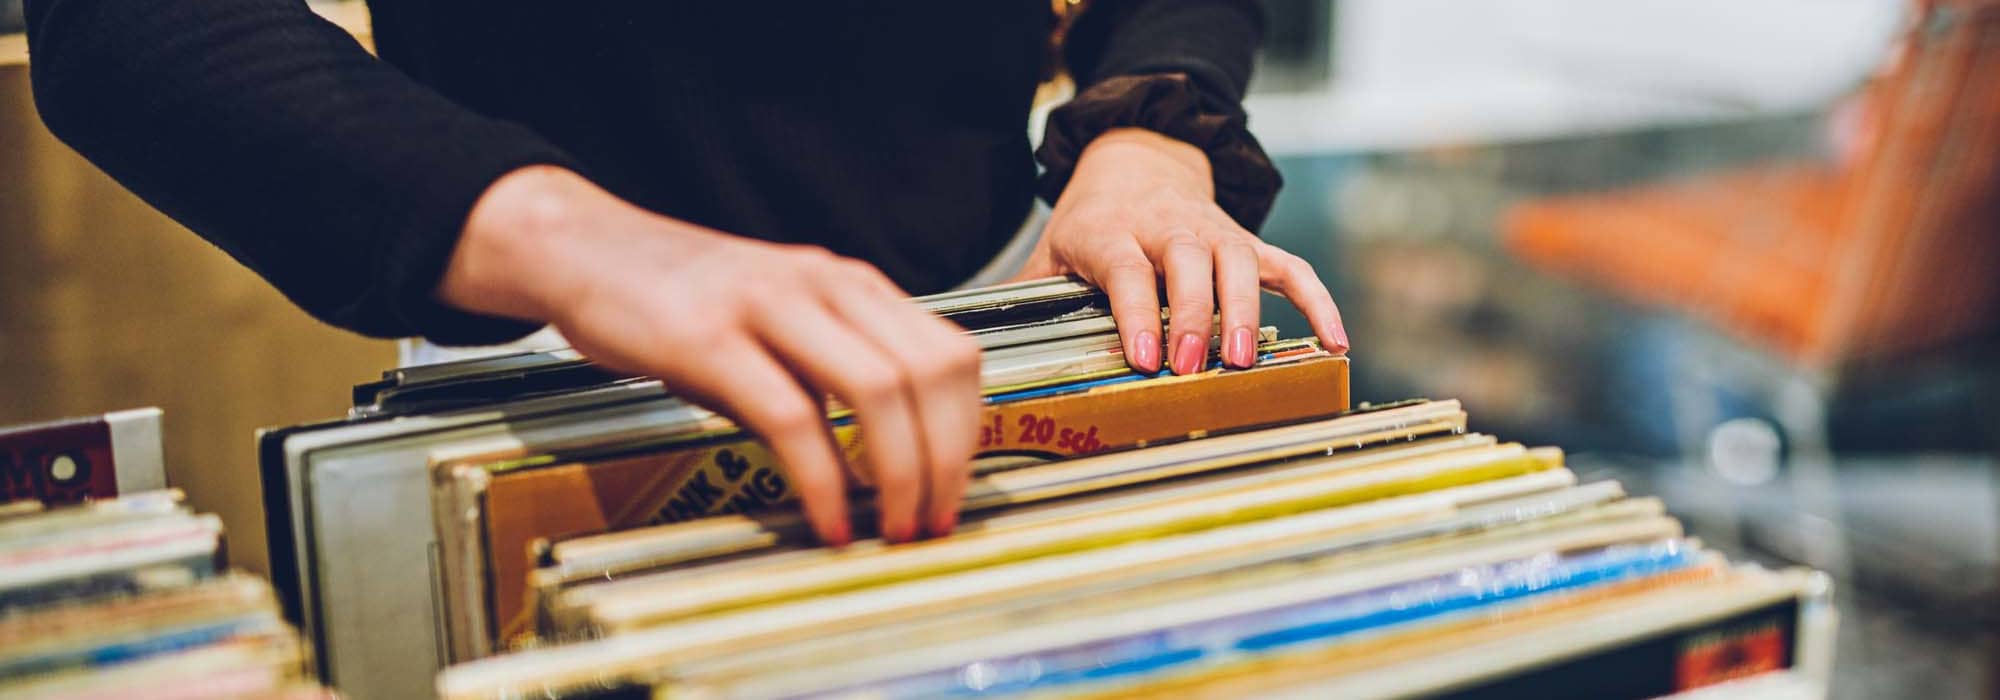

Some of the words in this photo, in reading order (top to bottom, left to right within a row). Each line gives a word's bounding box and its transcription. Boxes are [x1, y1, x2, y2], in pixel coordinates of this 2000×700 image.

[1018, 413, 1055, 445] 20
[1057, 425, 1111, 455] sch
[714, 448, 749, 482] &
